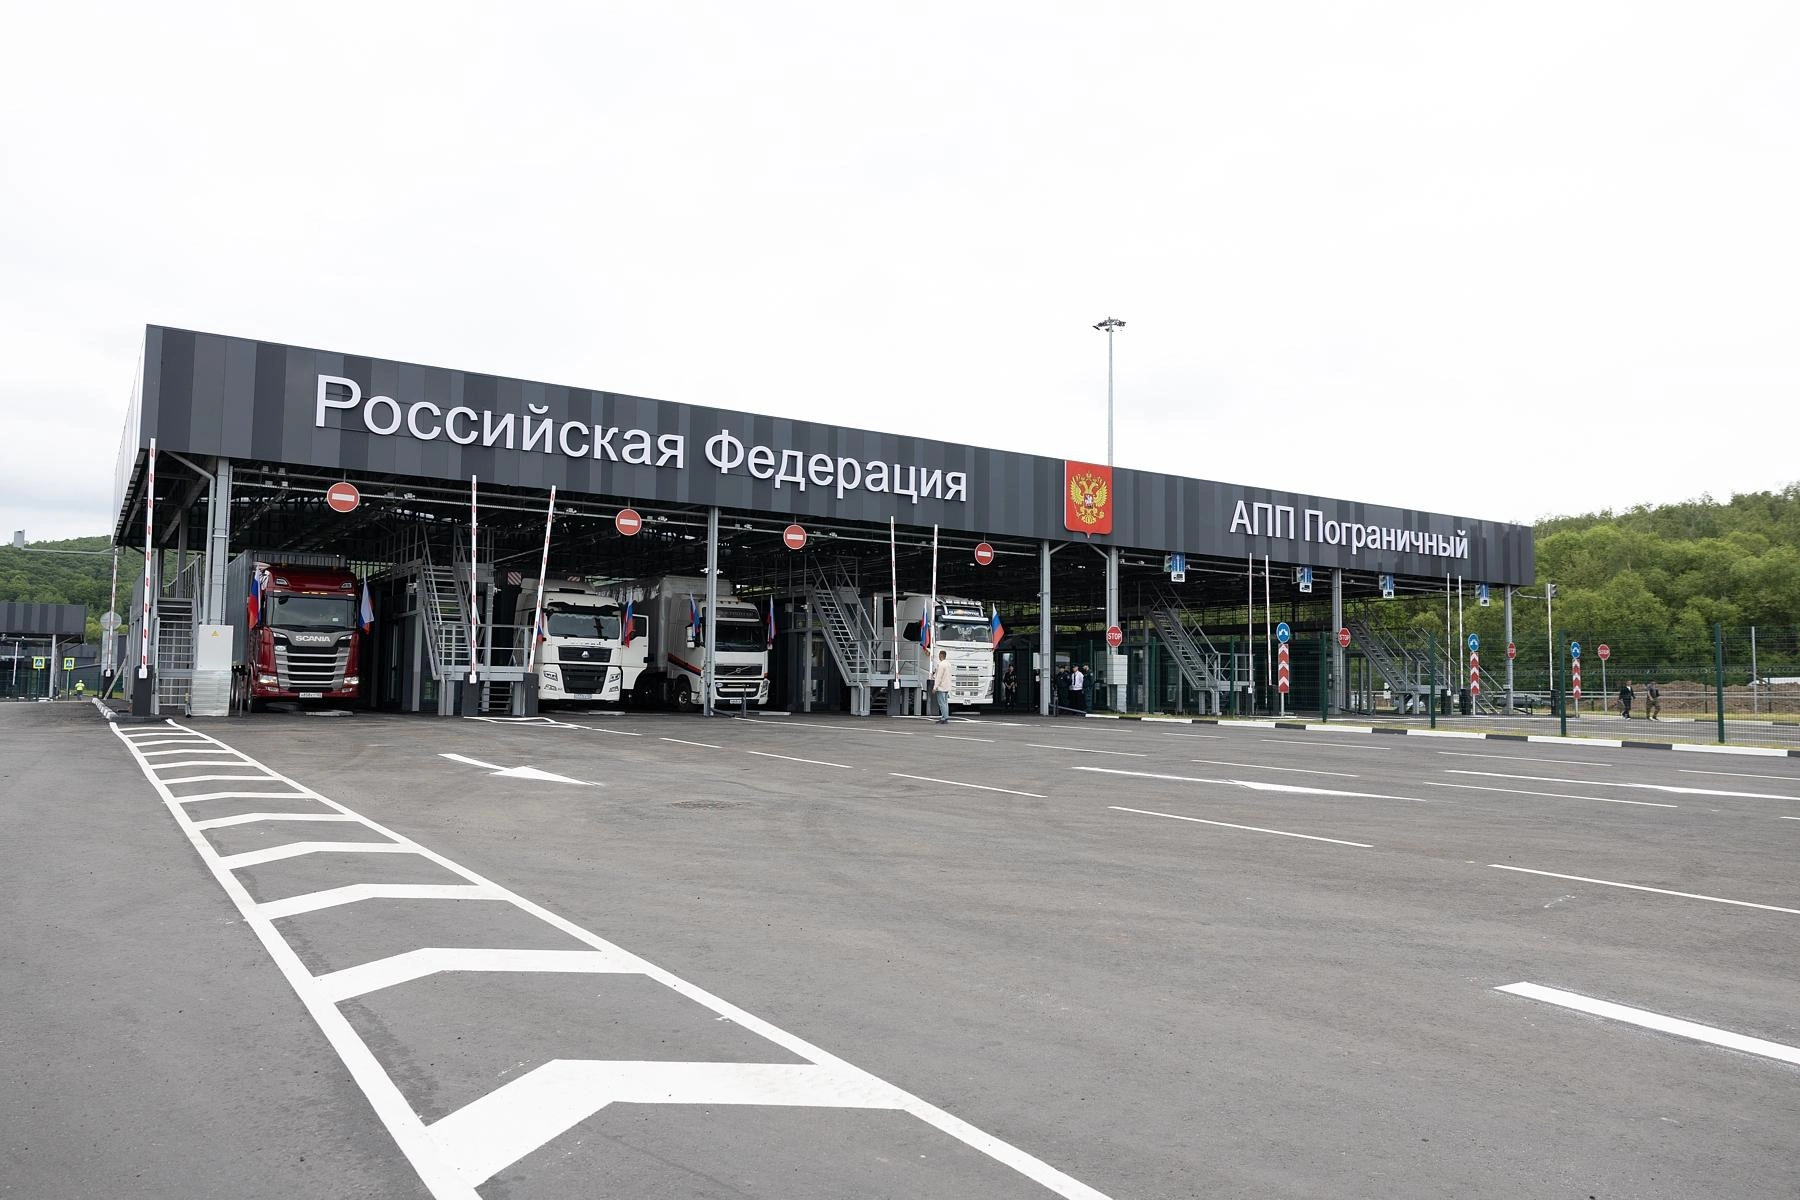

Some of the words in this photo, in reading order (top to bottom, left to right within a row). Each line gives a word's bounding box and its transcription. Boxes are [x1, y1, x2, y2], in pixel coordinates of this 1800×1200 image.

[315, 374, 685, 470] Российская
[704, 429, 968, 503] Федерация
[1230, 499, 1295, 539] АПП
[1304, 509, 1469, 560] Пограничный
[1108, 632, 1122, 640] STOP
